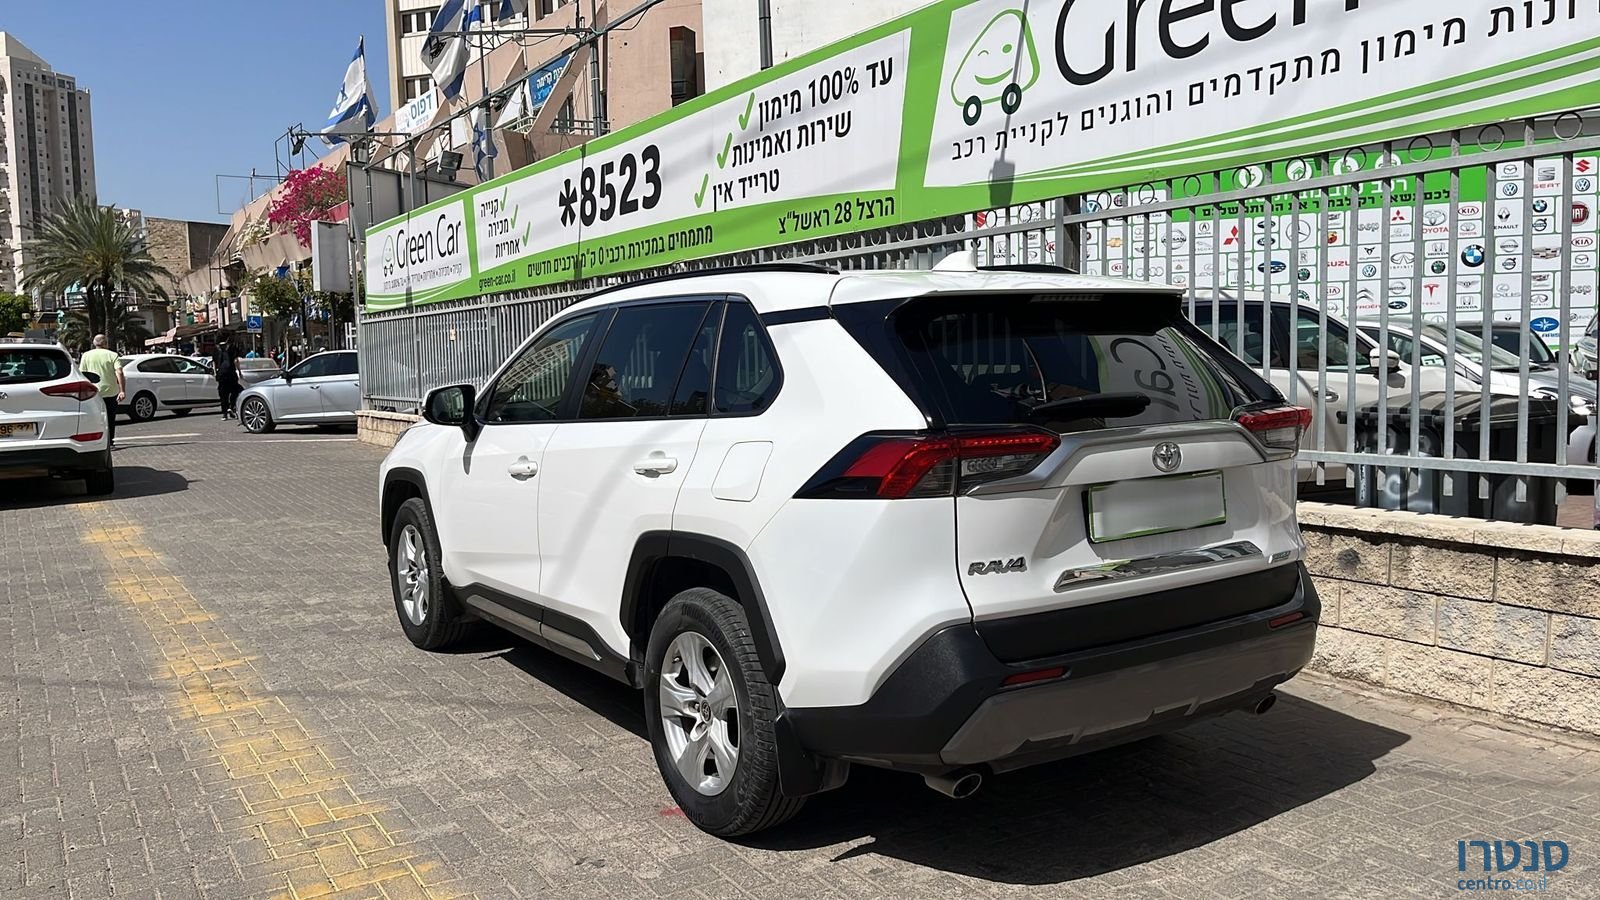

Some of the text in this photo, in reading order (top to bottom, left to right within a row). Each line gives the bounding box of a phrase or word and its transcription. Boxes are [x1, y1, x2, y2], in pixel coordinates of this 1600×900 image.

[951, 0, 1600, 160] ונות מימון מתקדמים והוגנים לקניית רכב
[758, 56, 893, 132] עד 100% מימון
[410, 93, 432, 120] דפוס
[731, 109, 852, 168] שירות ואמינות
[713, 168, 780, 212] טרייד אין
[1423, 188, 1450, 200] לכם
[480, 198, 499, 218] קנייה
[834, 200, 852, 224] 28
[856, 196, 895, 220] הרצל
[1202, 205, 1239, 216] שלם
[1313, 196, 1351, 209] לבחר
[1358, 196, 1375, 207] רק
[488, 218, 509, 238] מכירה
[668, 225, 713, 251] מתמחים
[396, 214, 461, 269] Green Car
[495, 238, 520, 259] אחריות
[628, 236, 665, 260] במכירת
[598, 246, 604, 265] 0
[606, 245, 626, 263] רכבי
[527, 260, 552, 277] חדשים
[479, 268, 516, 292] green-car.co.il
[1570, 285, 1592, 295] eep
[967, 556, 1027, 576] RAV4
